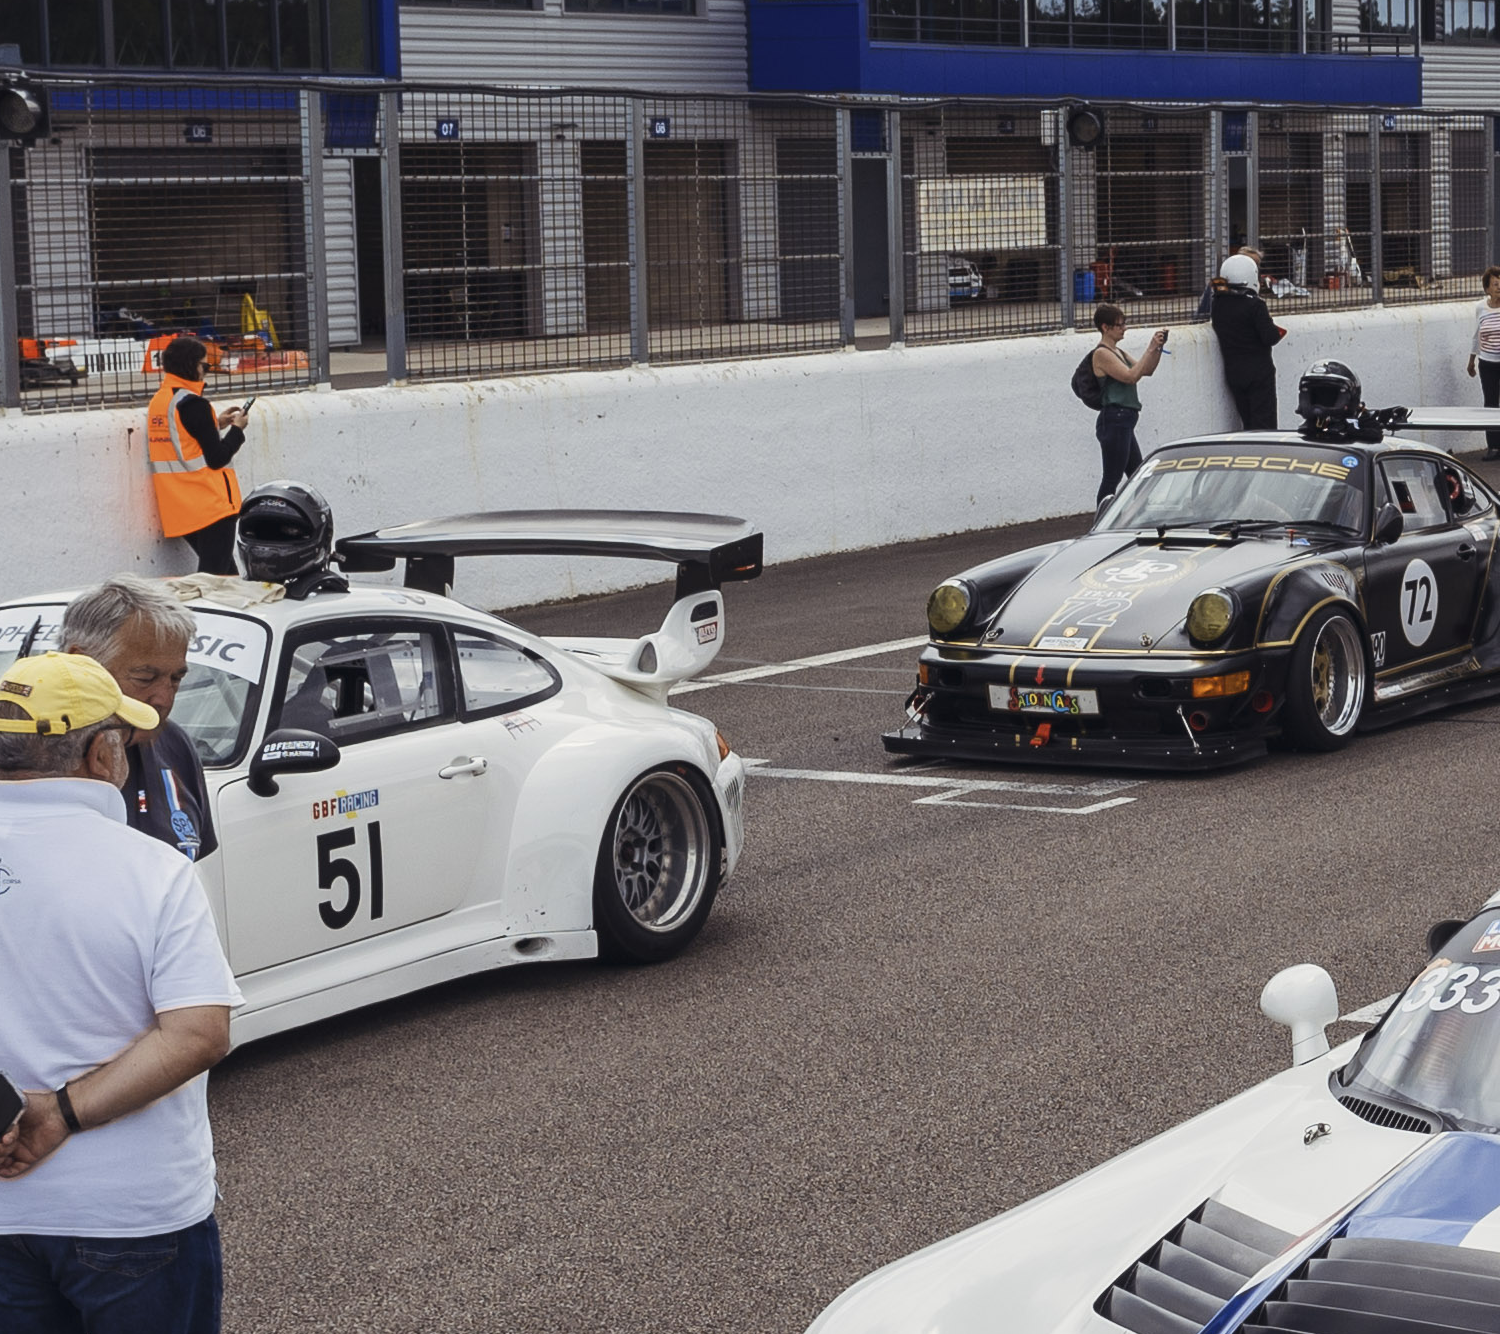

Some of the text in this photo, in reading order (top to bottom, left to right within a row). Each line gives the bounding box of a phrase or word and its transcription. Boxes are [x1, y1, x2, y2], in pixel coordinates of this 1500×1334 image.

[441, 122, 454, 136] 07
[1152, 455, 1350, 480] PORSCHE
[1050, 597, 1133, 628] 72
[1405, 575, 1433, 626] 72
[1372, 632, 1386, 660] 90
[312, 789, 377, 820] GBF RACING
[316, 820, 384, 931] 51
